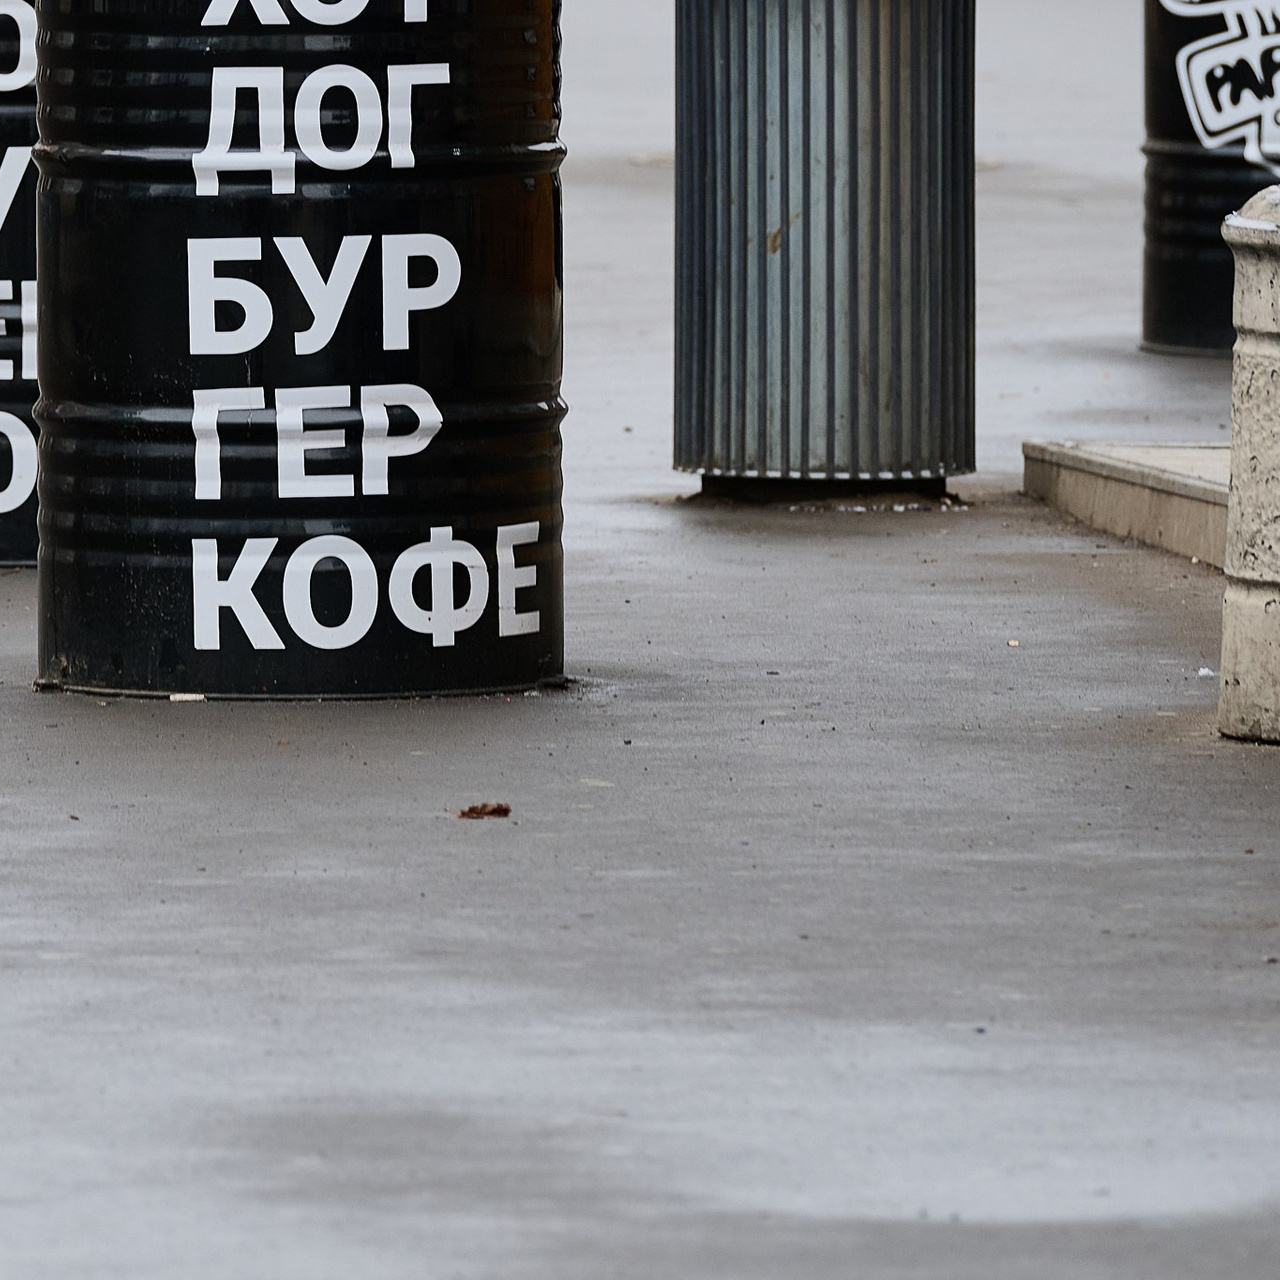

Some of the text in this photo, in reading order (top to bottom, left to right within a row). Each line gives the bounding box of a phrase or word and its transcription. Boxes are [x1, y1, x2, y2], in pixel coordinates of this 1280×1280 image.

[191, 63, 451, 196] ДОГ
[187, 233, 462, 356] БУР
[191, 383, 444, 501] ГЕР
[191, 521, 541, 651] КОФЕ
